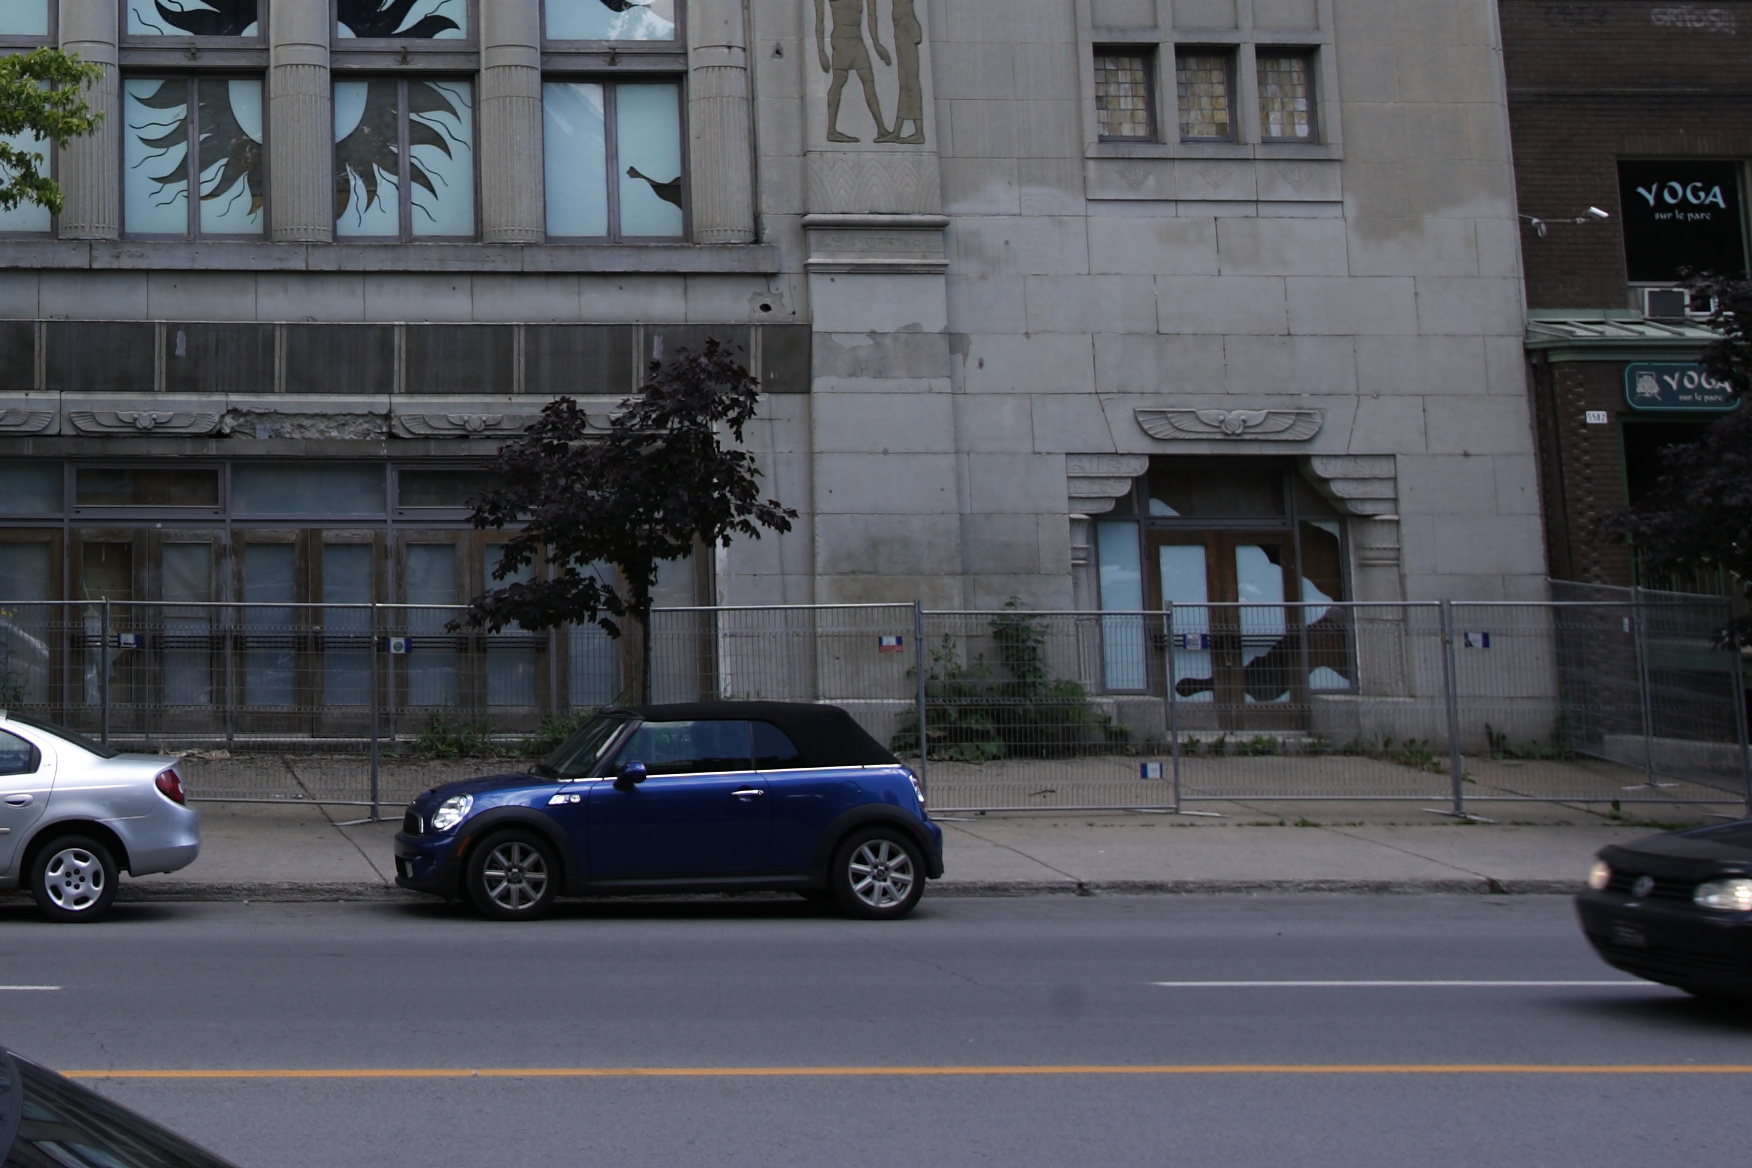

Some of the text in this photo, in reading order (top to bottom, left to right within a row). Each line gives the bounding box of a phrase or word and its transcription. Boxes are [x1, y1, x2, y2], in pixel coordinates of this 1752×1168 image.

[1636, 181, 1726, 208] YOGA
[1655, 209, 1711, 222] sur le parc
[1663, 371, 1732, 392] YOGA
